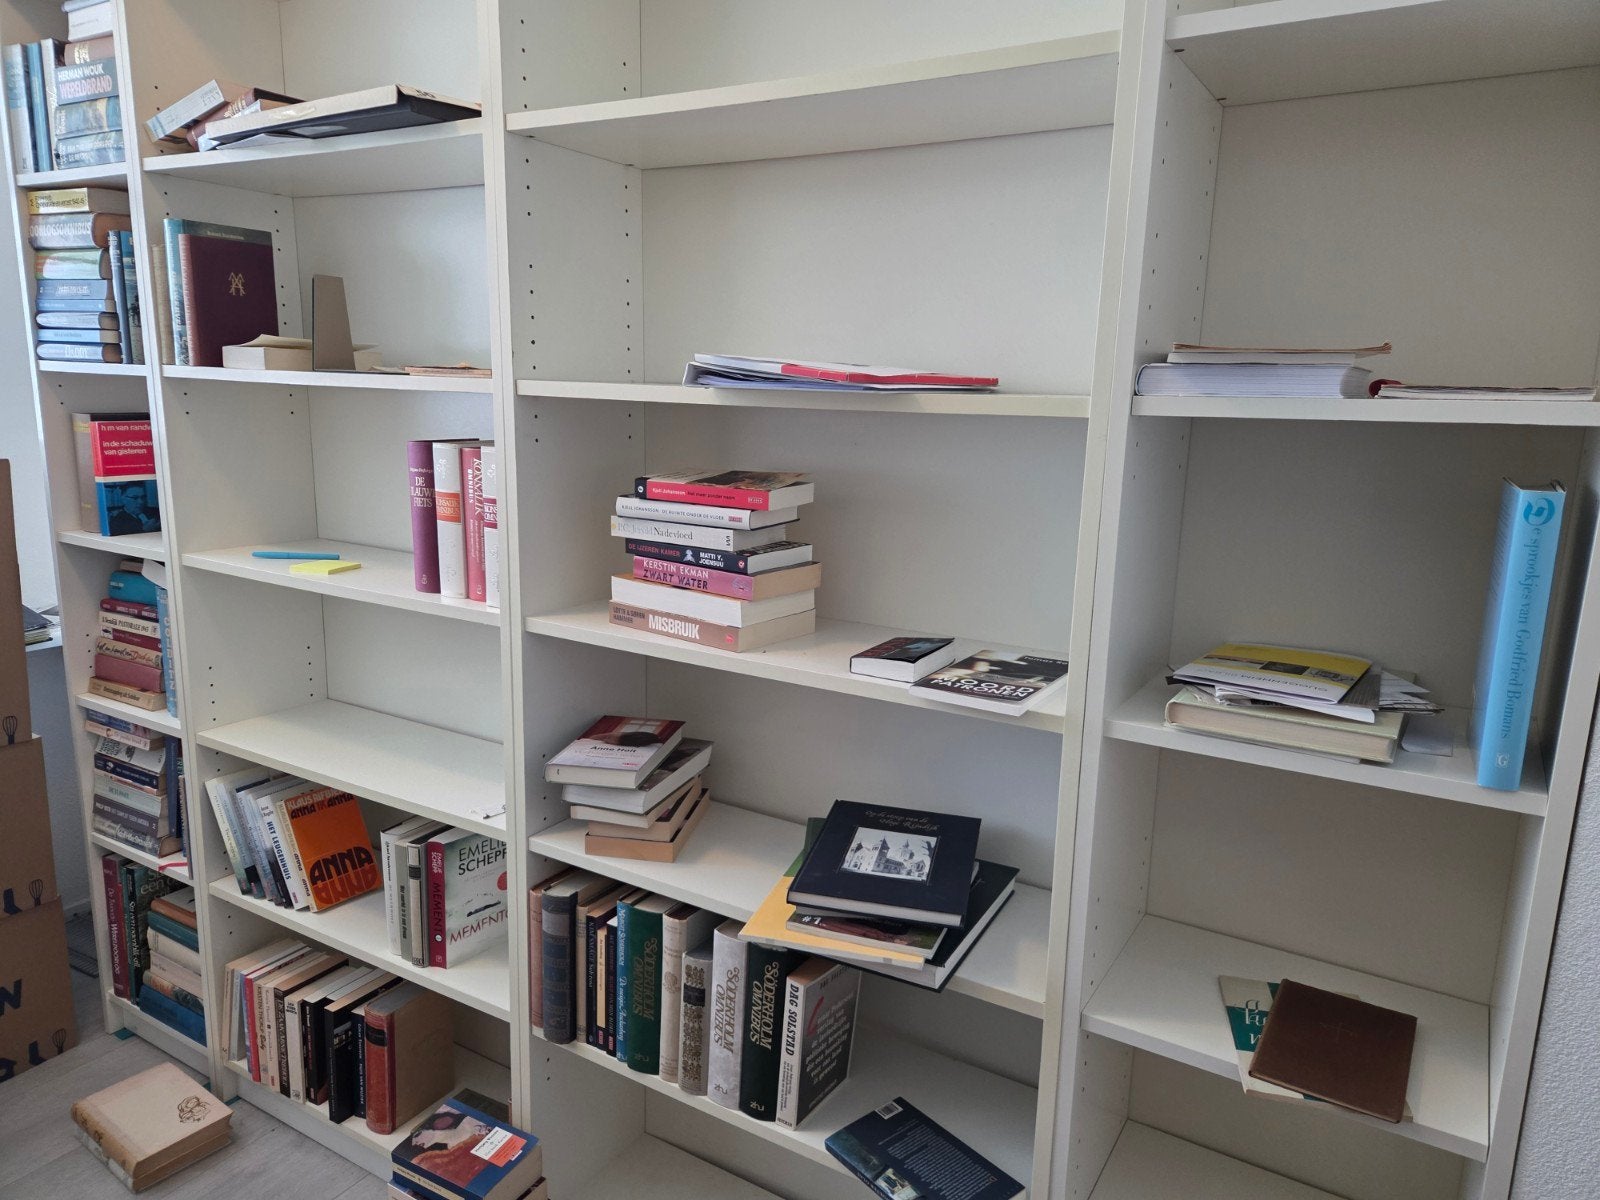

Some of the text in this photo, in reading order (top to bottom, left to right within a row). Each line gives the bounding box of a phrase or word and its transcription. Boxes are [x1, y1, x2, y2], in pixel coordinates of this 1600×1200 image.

[58, 63, 104, 82] HERMAN WOUK
[60, 75, 113, 99] WERELDBRAND
[118, 448, 146, 456] gisteren
[120, 439, 153, 447] schaduw
[415, 476, 425, 487] DE
[473, 458, 483, 517] KONSALIK
[413, 497, 433, 508] FIETS
[699, 552, 715, 561] MATTI
[1519, 538, 1540, 597] sprookjes
[643, 560, 709, 579] KERSTIN EKMAN
[643, 569, 708, 590] ZWART WATER
[1518, 599, 1531, 625] van
[648, 614, 700, 640] MISBRUIK
[1509, 628, 1531, 687] Godfried
[930, 678, 1028, 698] PATRONEN
[937, 675, 1035, 694] MOORD
[1502, 689, 1522, 738] Bomans
[590, 744, 637, 754] Anne Holt
[287, 795, 311, 809] KLAUS
[290, 803, 316, 819] ANNA
[267, 821, 292, 880] HET LEUGENHUIS
[309, 846, 374, 886] ANNA
[632, 956, 645, 1019] OMNIBUS
[639, 937, 659, 1021] SÖDERHOLM
[759, 961, 780, 1050] SÖDERHOLM
[788, 983, 799, 1008] DAG
[713, 983, 725, 1048] OMNIBUS
[723, 966, 740, 1054] SÖDERHOLM
[750, 981, 763, 1045] OMNIBUS
[785, 1009, 798, 1056] SOLSTAD
